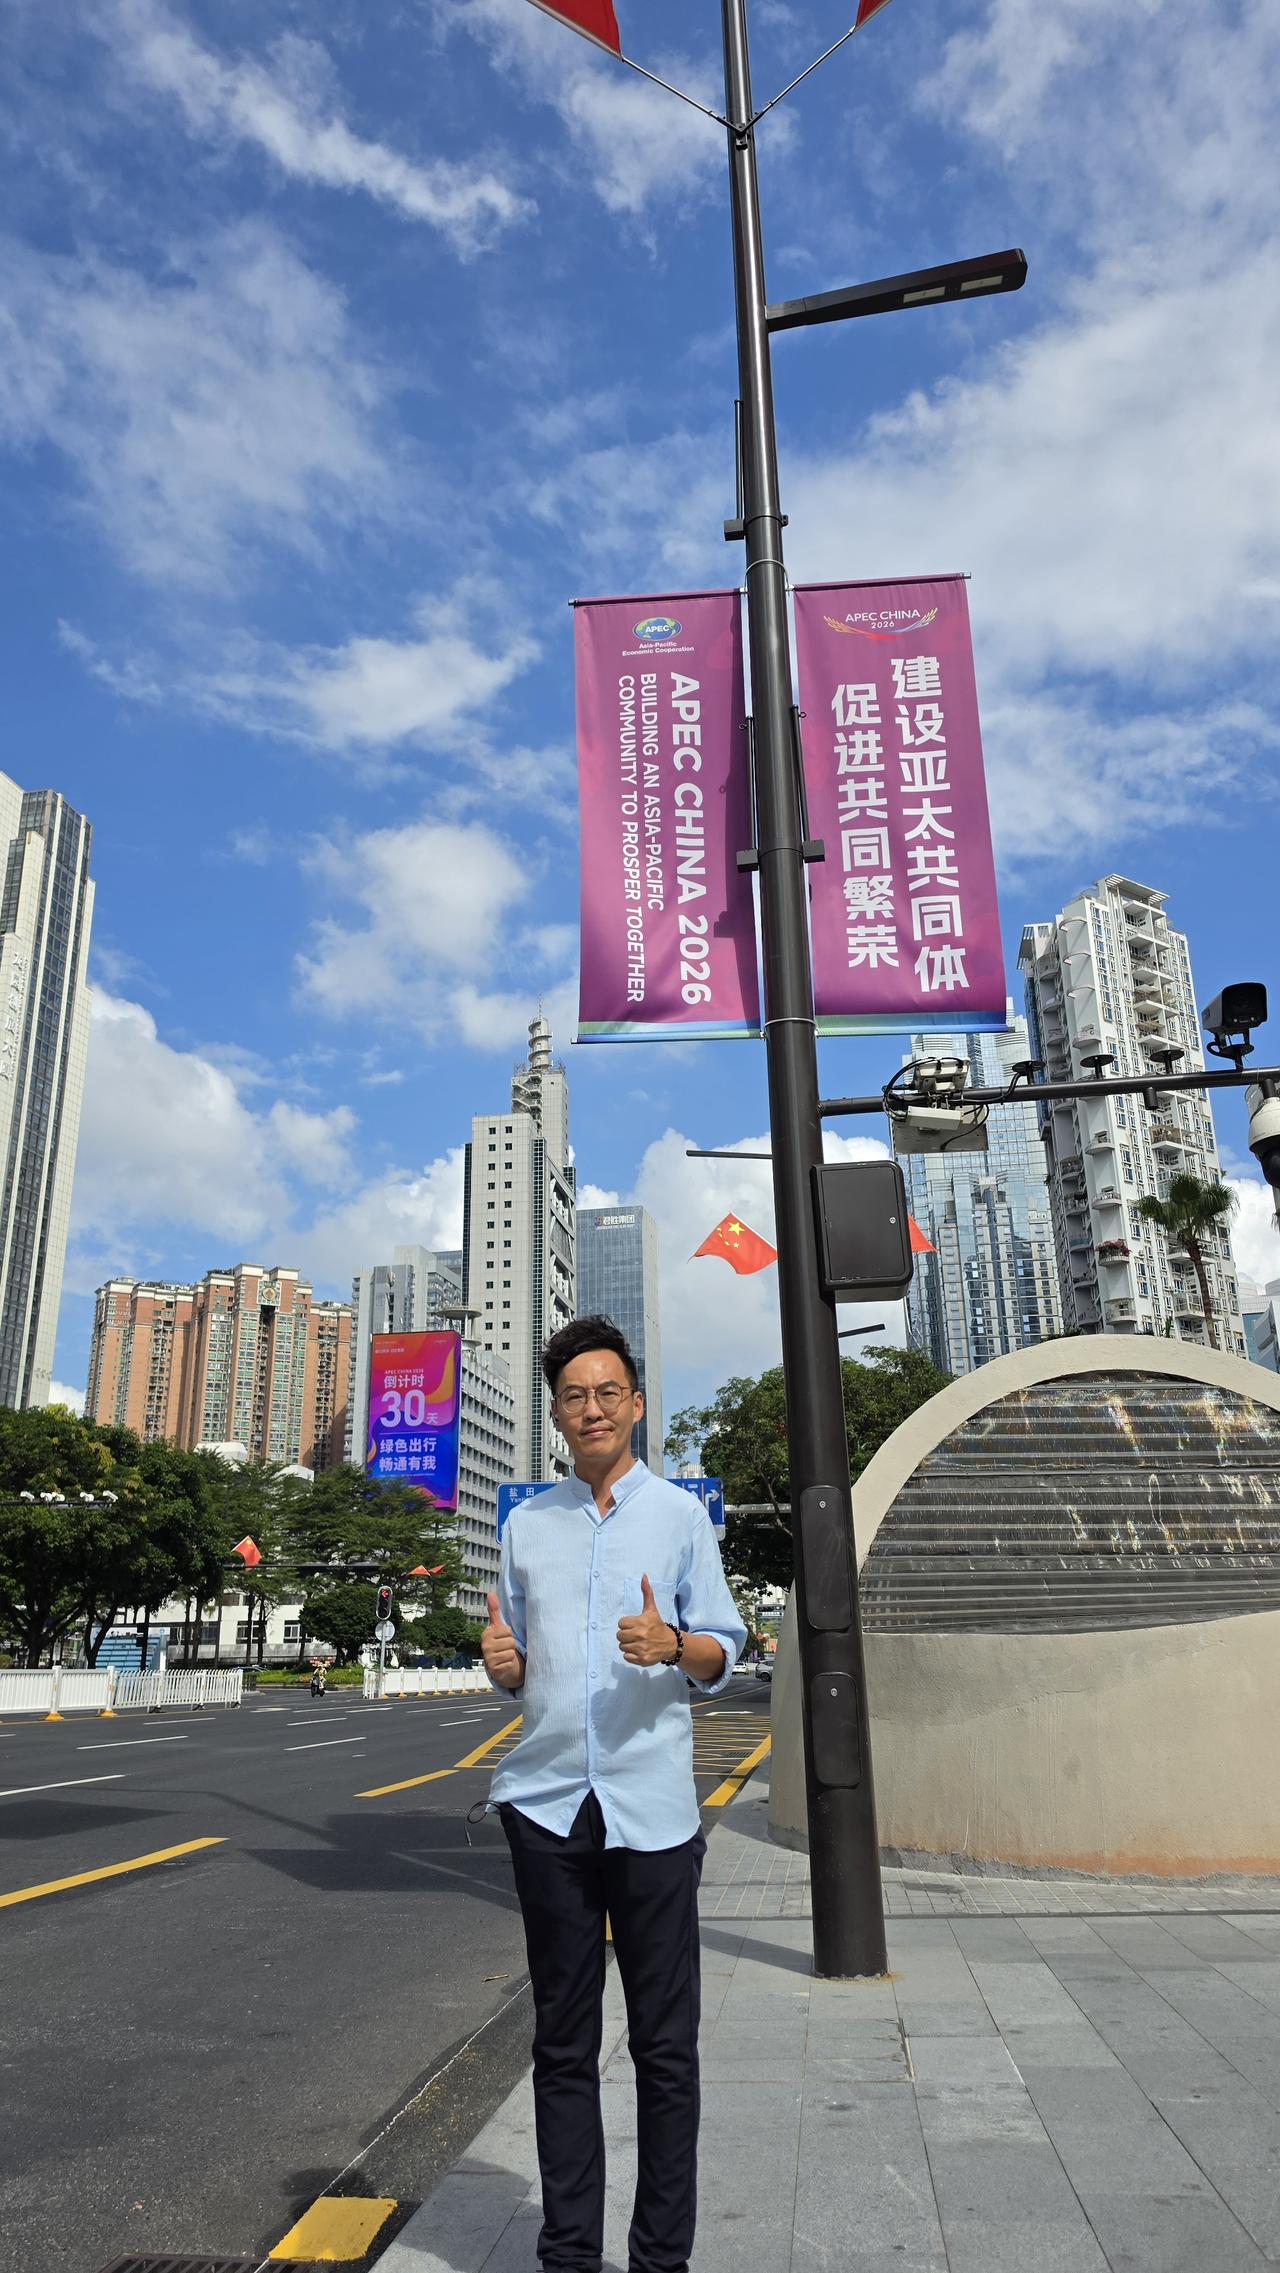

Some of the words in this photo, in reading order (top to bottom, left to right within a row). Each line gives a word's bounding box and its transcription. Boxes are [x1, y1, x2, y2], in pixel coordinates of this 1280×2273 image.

[845, 612, 877, 622] APEC
[880, 609, 920, 620] CHINA
[871, 621, 894, 629] 2026
[645, 625, 670, 633] APEC
[622, 649, 653, 657] Economic
[655, 646, 695, 654] Cooperation
[639, 641, 677, 649] Asia-Pacific
[640, 673, 659, 756] BUILDING
[670, 672, 702, 772] APEC
[618, 675, 637, 785] COMMUNITY
[643, 762, 660, 788] AN
[621, 790, 638, 815] TO
[831, 683, 899, 968] 促进共同繁荣
[891, 655, 970, 993] 建设亚太共同体
[643, 794, 664, 912] ASIA-PACIFIC
[674, 782, 707, 904] CHINA
[622, 821, 641, 900] PROSPER
[626, 906, 645, 1002] TOGETHER
[678, 914, 712, 1005] 2026
[384, 1374, 424, 1389] 倒计时
[380, 1437, 437, 1453] 绿色出行
[379, 1455, 437, 1472] 畅通有我
[509, 1487, 534, 1497] 盐田
